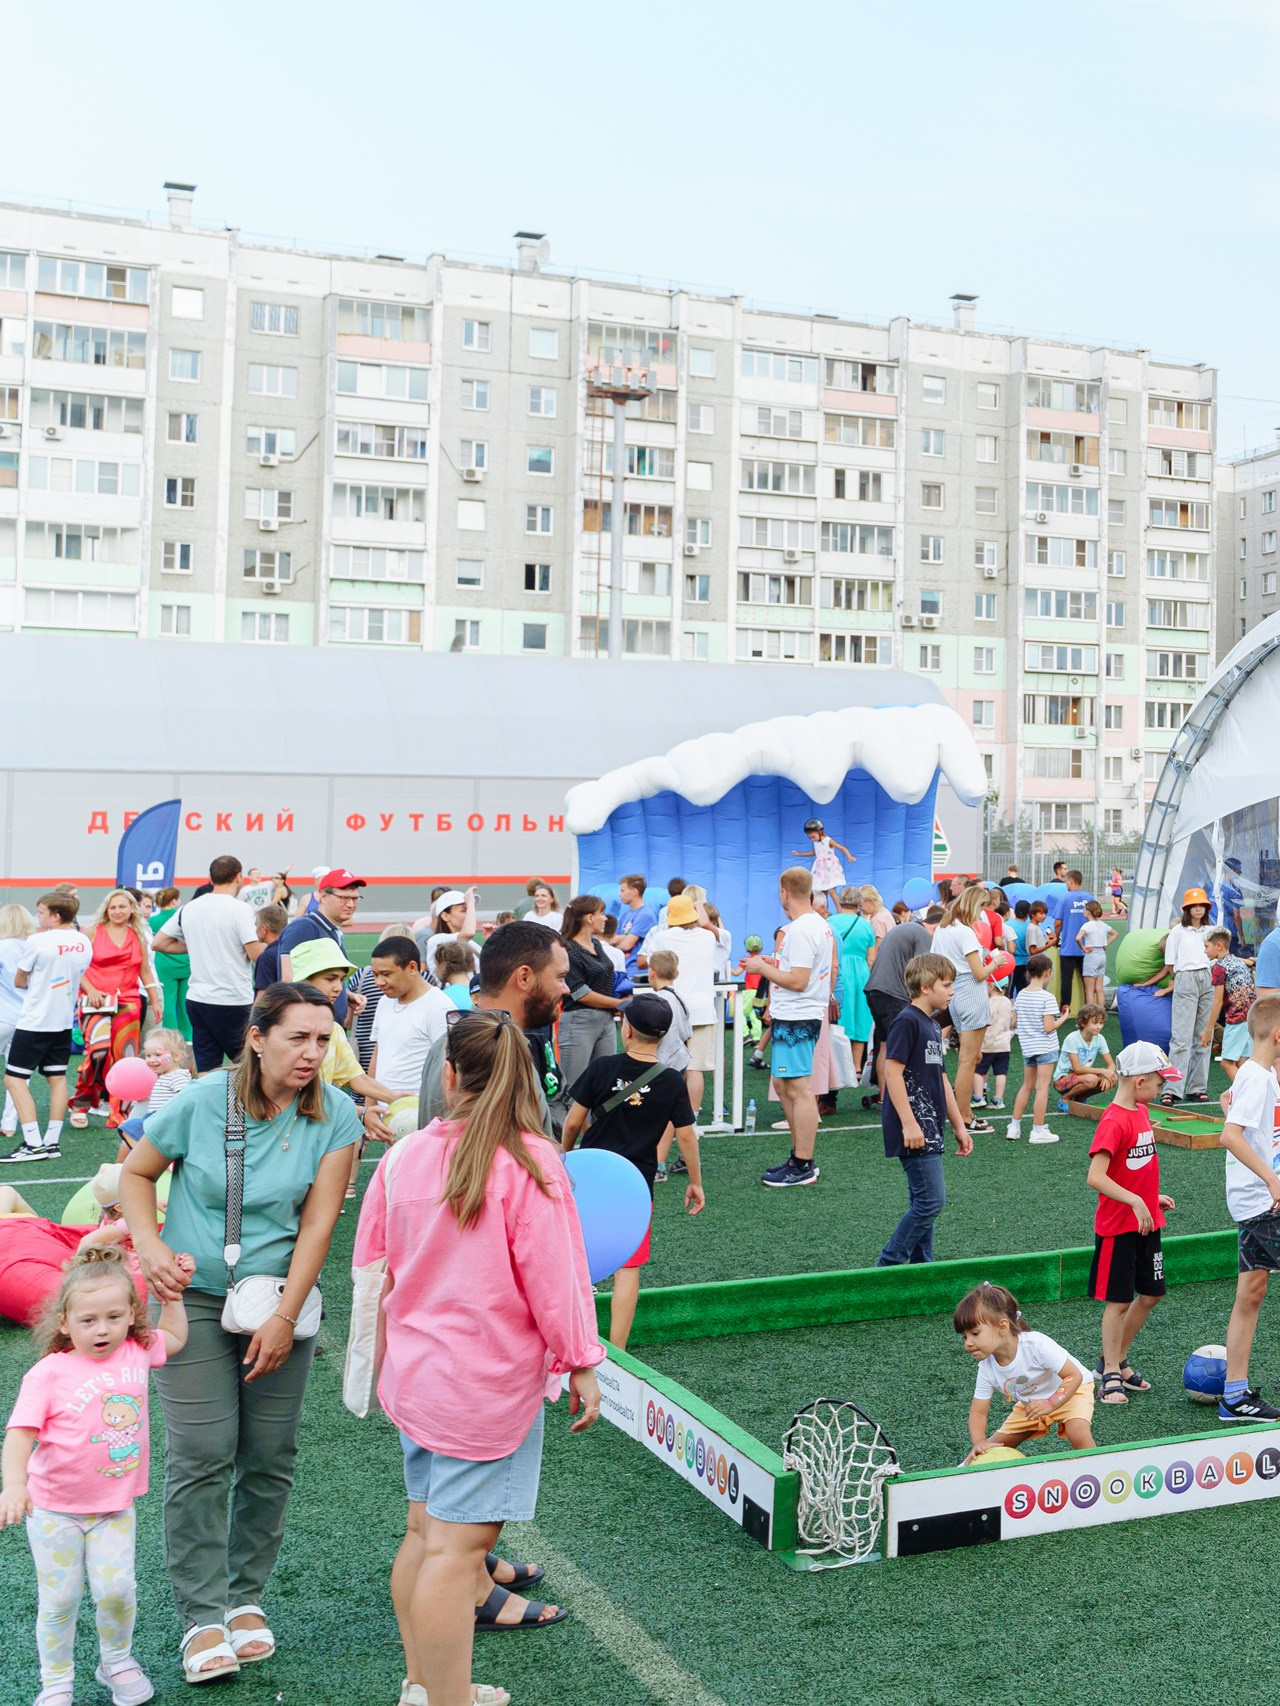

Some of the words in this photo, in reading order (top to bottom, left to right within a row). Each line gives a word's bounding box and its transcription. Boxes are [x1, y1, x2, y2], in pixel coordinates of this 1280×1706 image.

[87, 807, 294, 834] ДЕСКИЙ
[1128, 1146, 1148, 1157] JUST
[66, 1371, 116, 1413] LET'S
[647, 1403, 738, 1501] SNOOKBALL
